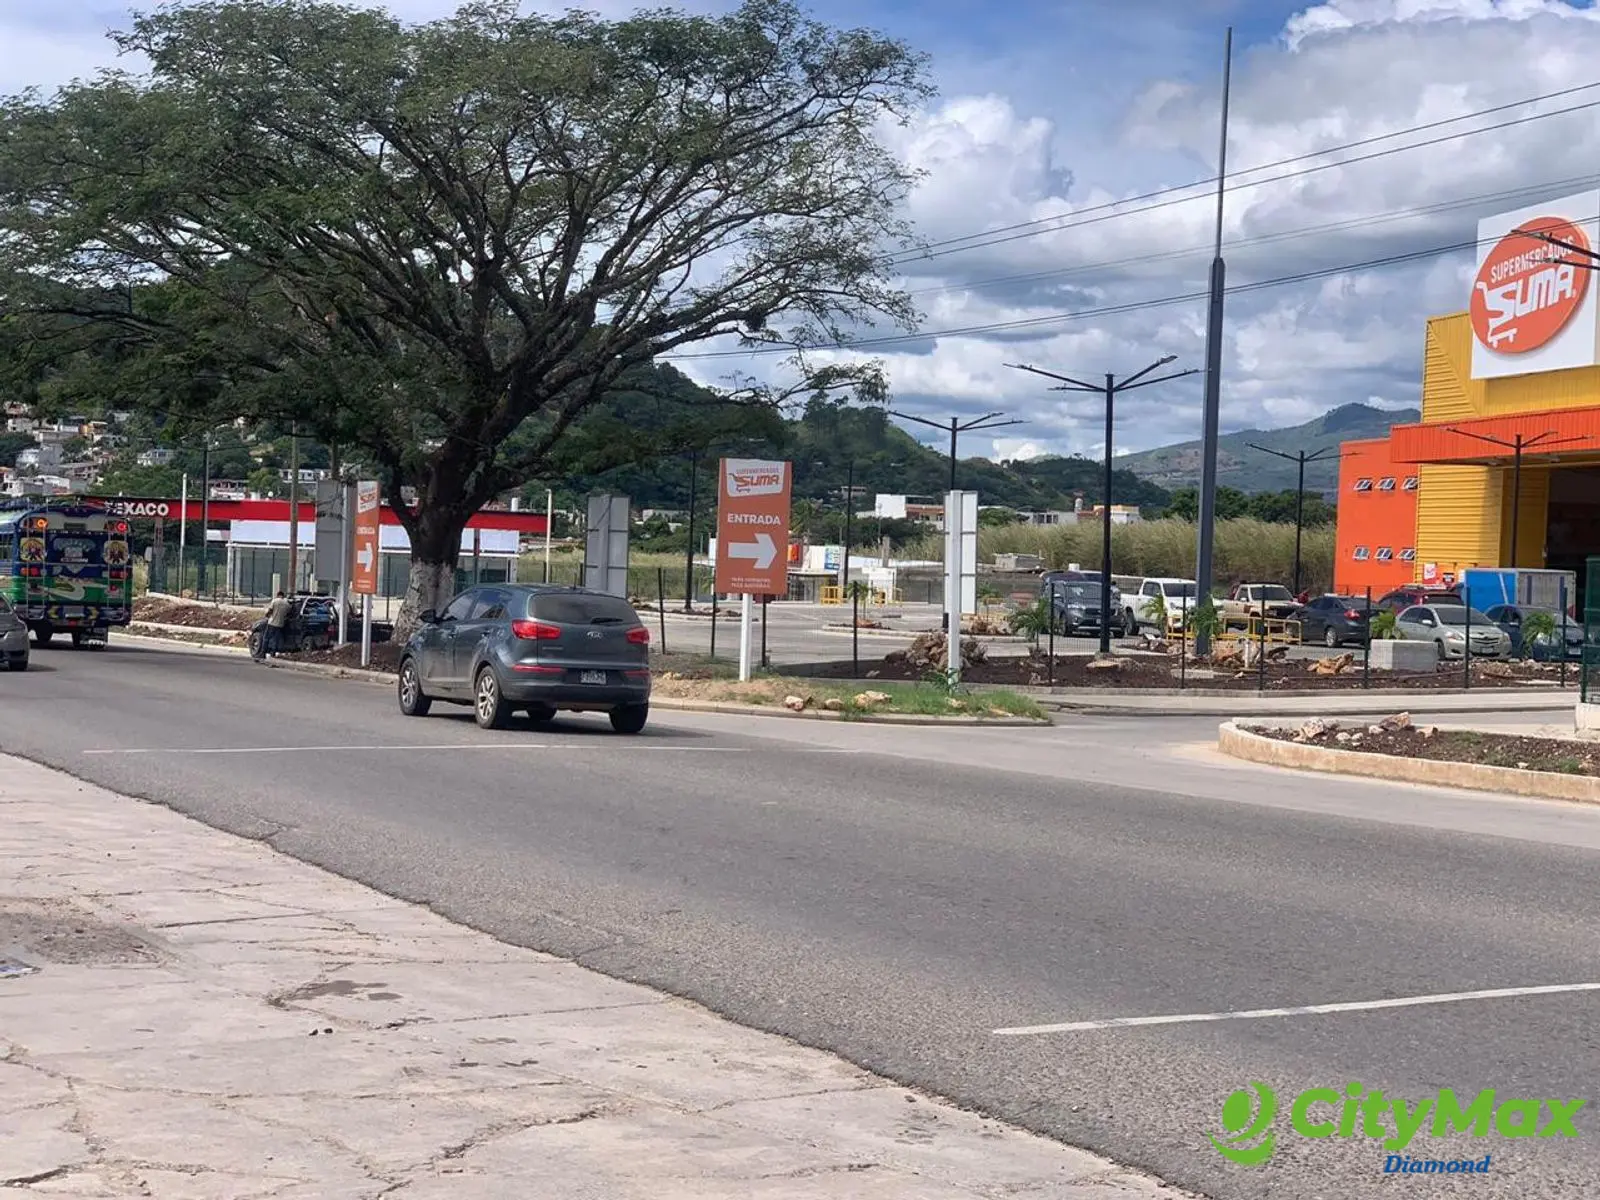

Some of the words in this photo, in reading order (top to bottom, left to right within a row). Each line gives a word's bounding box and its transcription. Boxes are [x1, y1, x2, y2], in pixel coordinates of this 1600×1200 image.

[1482, 263, 1575, 331] SUMA
[734, 474, 780, 487] SUMA
[727, 513, 781, 525] ENTRADA
